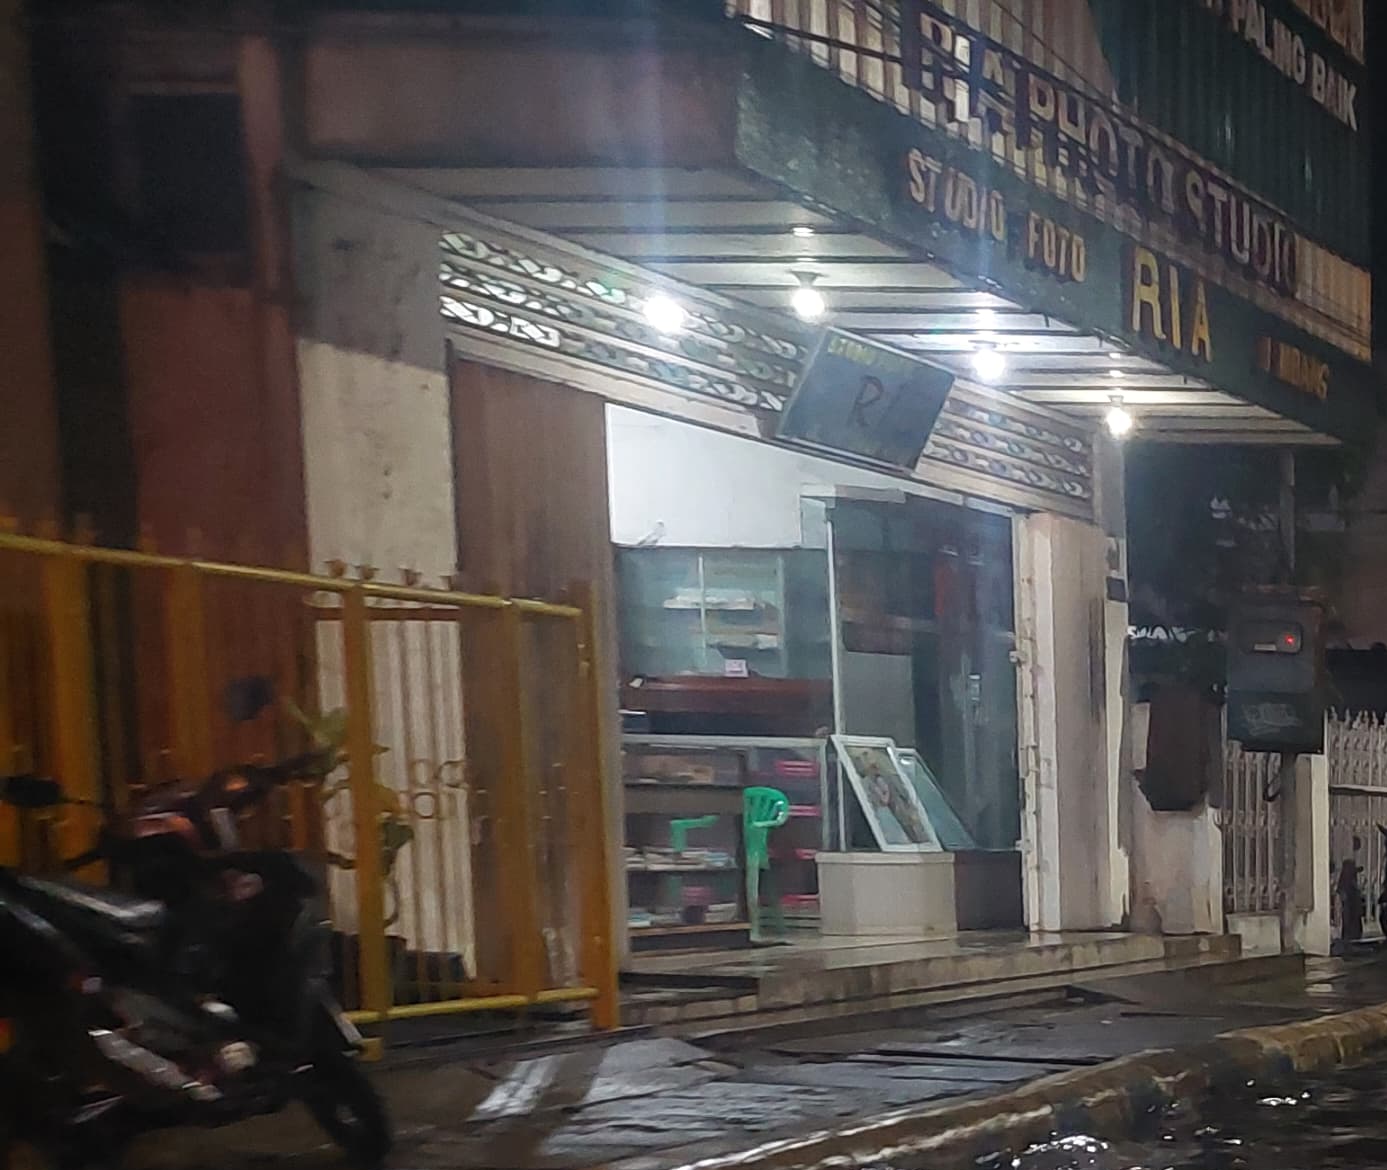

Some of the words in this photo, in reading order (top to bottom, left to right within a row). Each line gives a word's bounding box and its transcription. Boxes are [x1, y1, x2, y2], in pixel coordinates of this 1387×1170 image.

[908, 148, 1007, 242] STUDIO
[1028, 210, 1087, 283] FOTO
[1131, 245, 1213, 363] RIA
